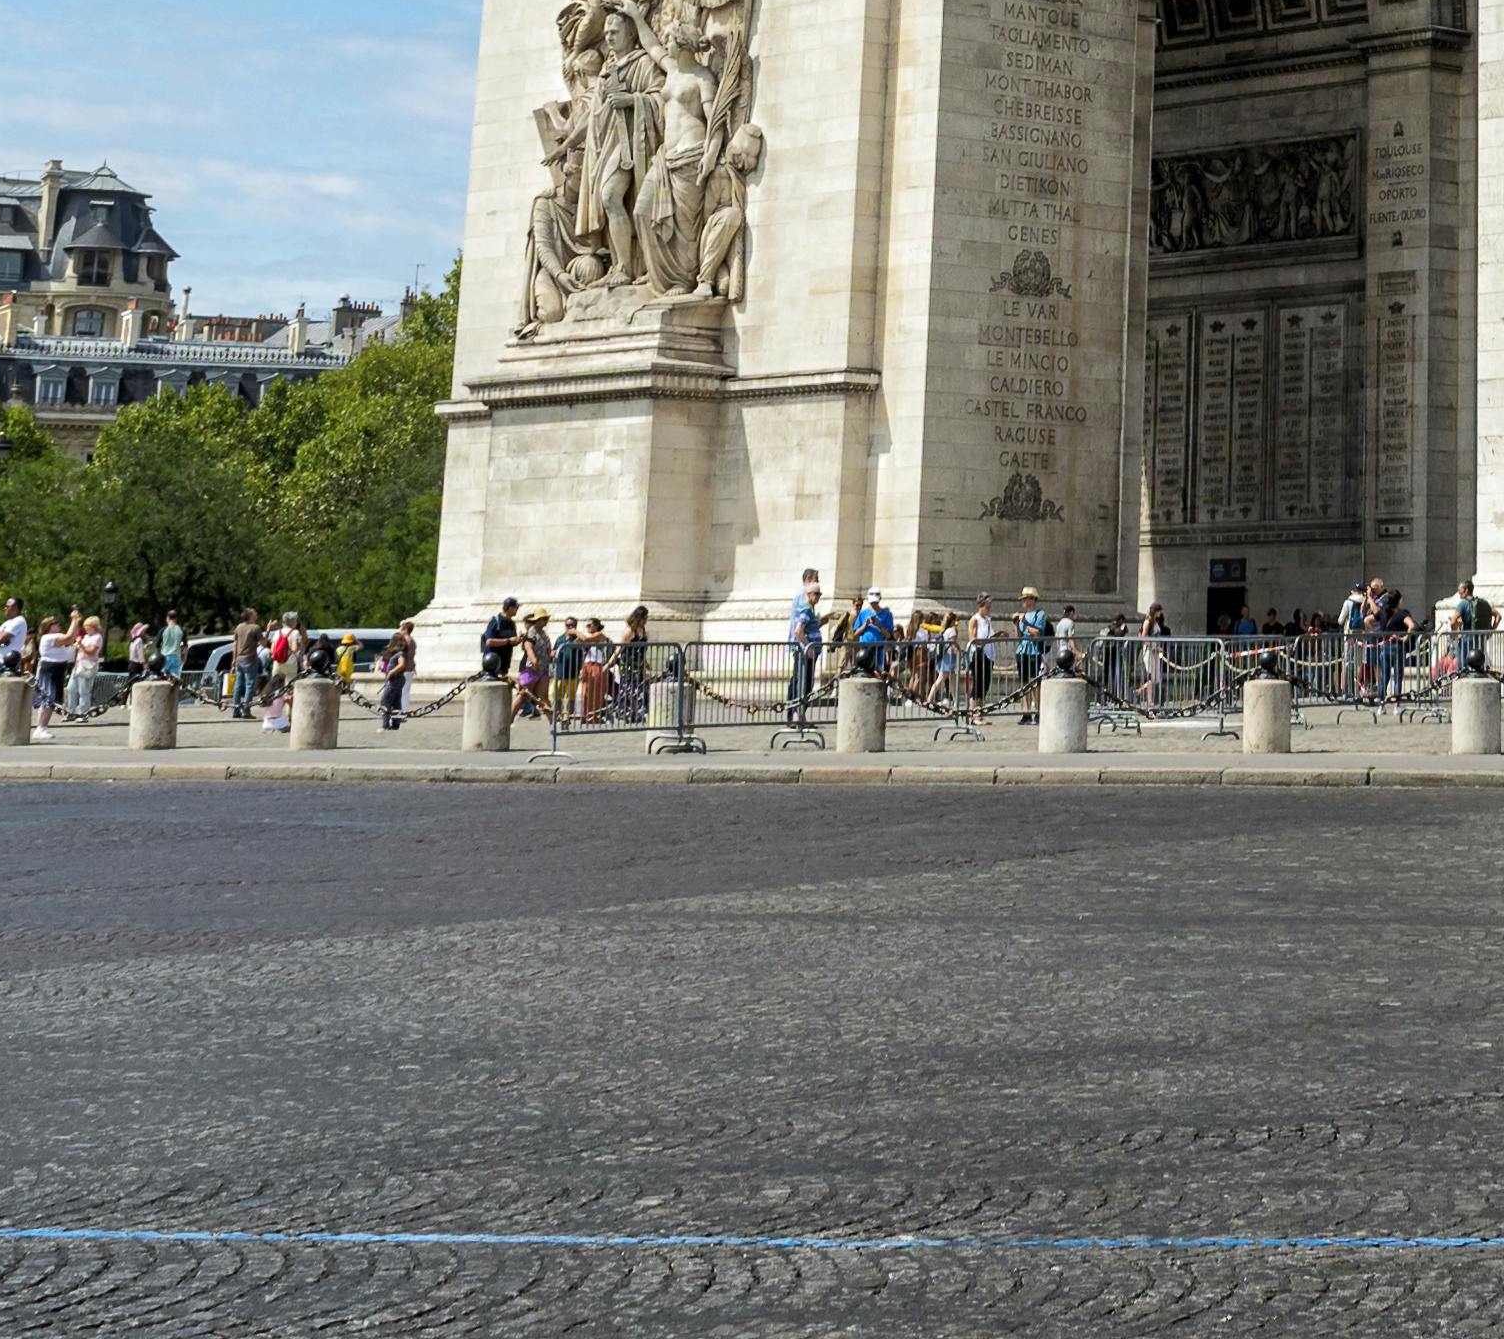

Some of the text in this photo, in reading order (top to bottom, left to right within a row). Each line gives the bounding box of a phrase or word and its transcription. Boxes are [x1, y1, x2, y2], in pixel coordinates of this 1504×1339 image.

[1003, 3, 1079, 28] MANTOUE
[989, 24, 1091, 54] TAGLIAMENTO
[1006, 51, 1073, 75] SEDIMAN
[985, 74, 1093, 103] MONT THABOR
[993, 98, 1082, 125] CHEBREISSE
[991, 122, 1083, 148] BASSIGNANO
[982, 147, 1089, 175] SAN GIULIANO
[1374, 143, 1423, 160] TOULOUSE
[1000, 173, 1070, 196] DIETIKON
[1378, 187, 1418, 201] OPORTO
[988, 198, 1038, 219] MUTTA
[1008, 225, 1058, 245] GENES
[1003, 301, 1058, 320] LE VAR
[978, 323, 1079, 347] MONTEBELLO
[987, 349, 1069, 372] LE MINCIO
[990, 376, 1064, 397] CALDIERO
[964, 398, 1087, 423] CASTEL FRANCO
[994, 426, 1057, 445] RAGUSE
[999, 451, 1049, 470] GAETE
